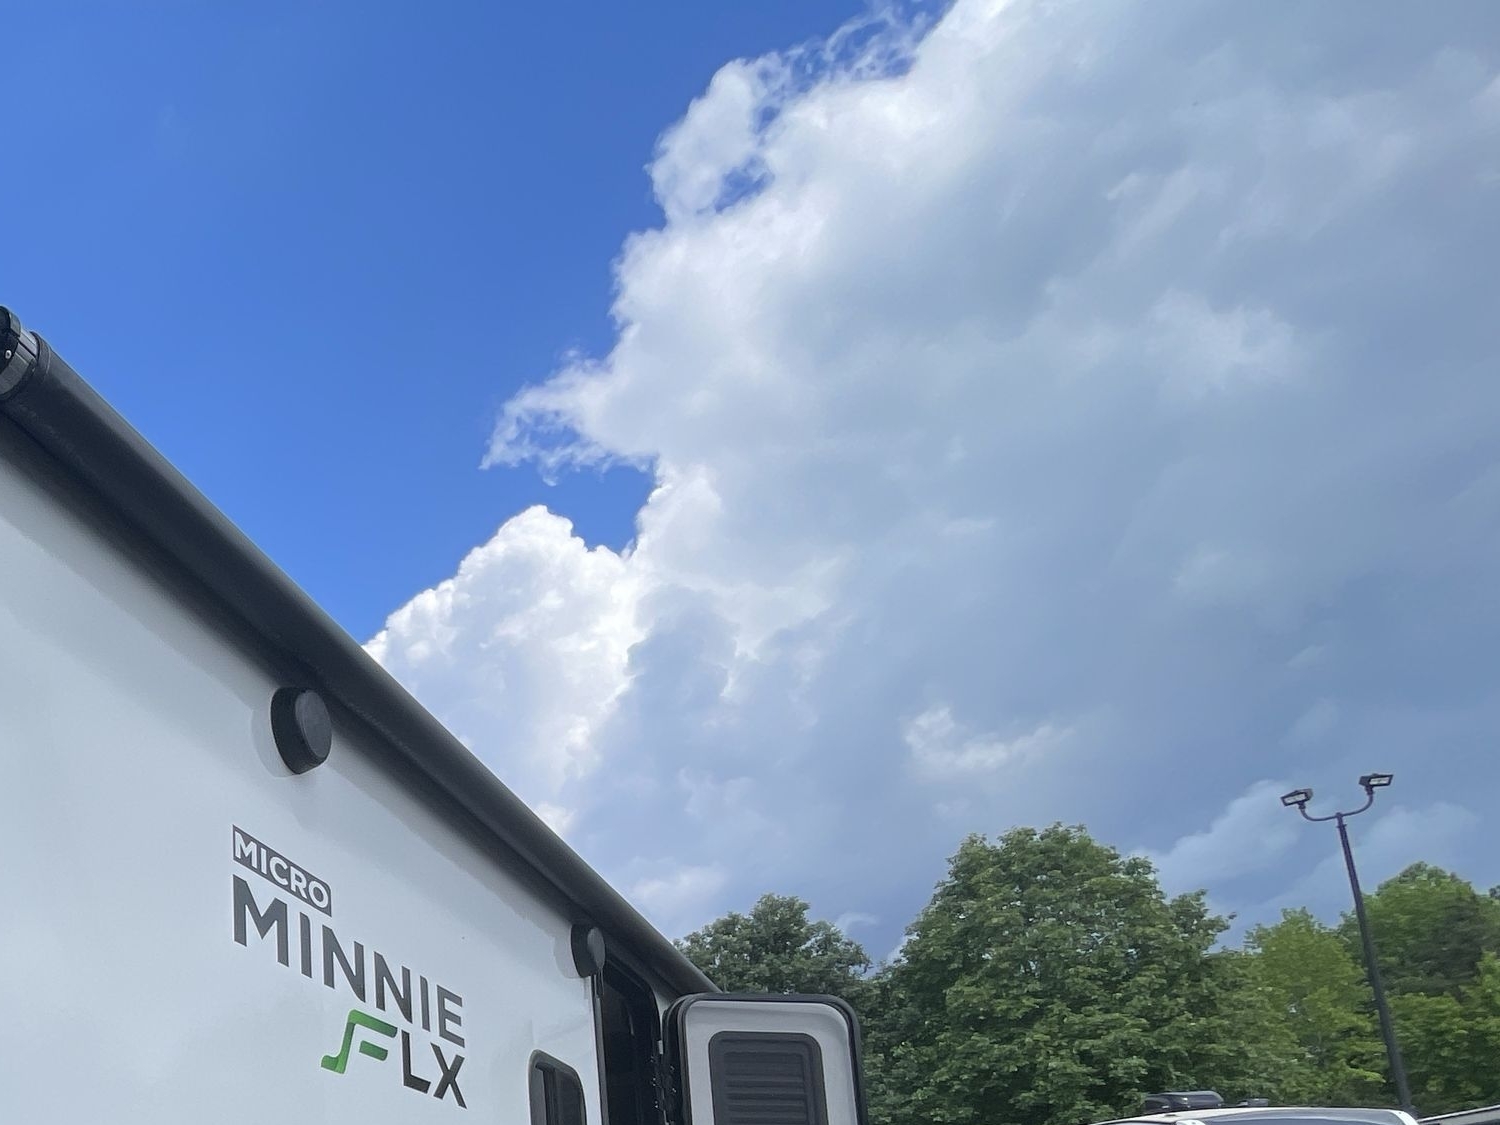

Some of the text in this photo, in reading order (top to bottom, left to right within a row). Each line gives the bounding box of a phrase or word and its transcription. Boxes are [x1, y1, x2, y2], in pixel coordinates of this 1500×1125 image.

[234, 831, 330, 909] MICRO
[232, 874, 465, 1049] MINNIE
[320, 1009, 467, 1110] FLX
